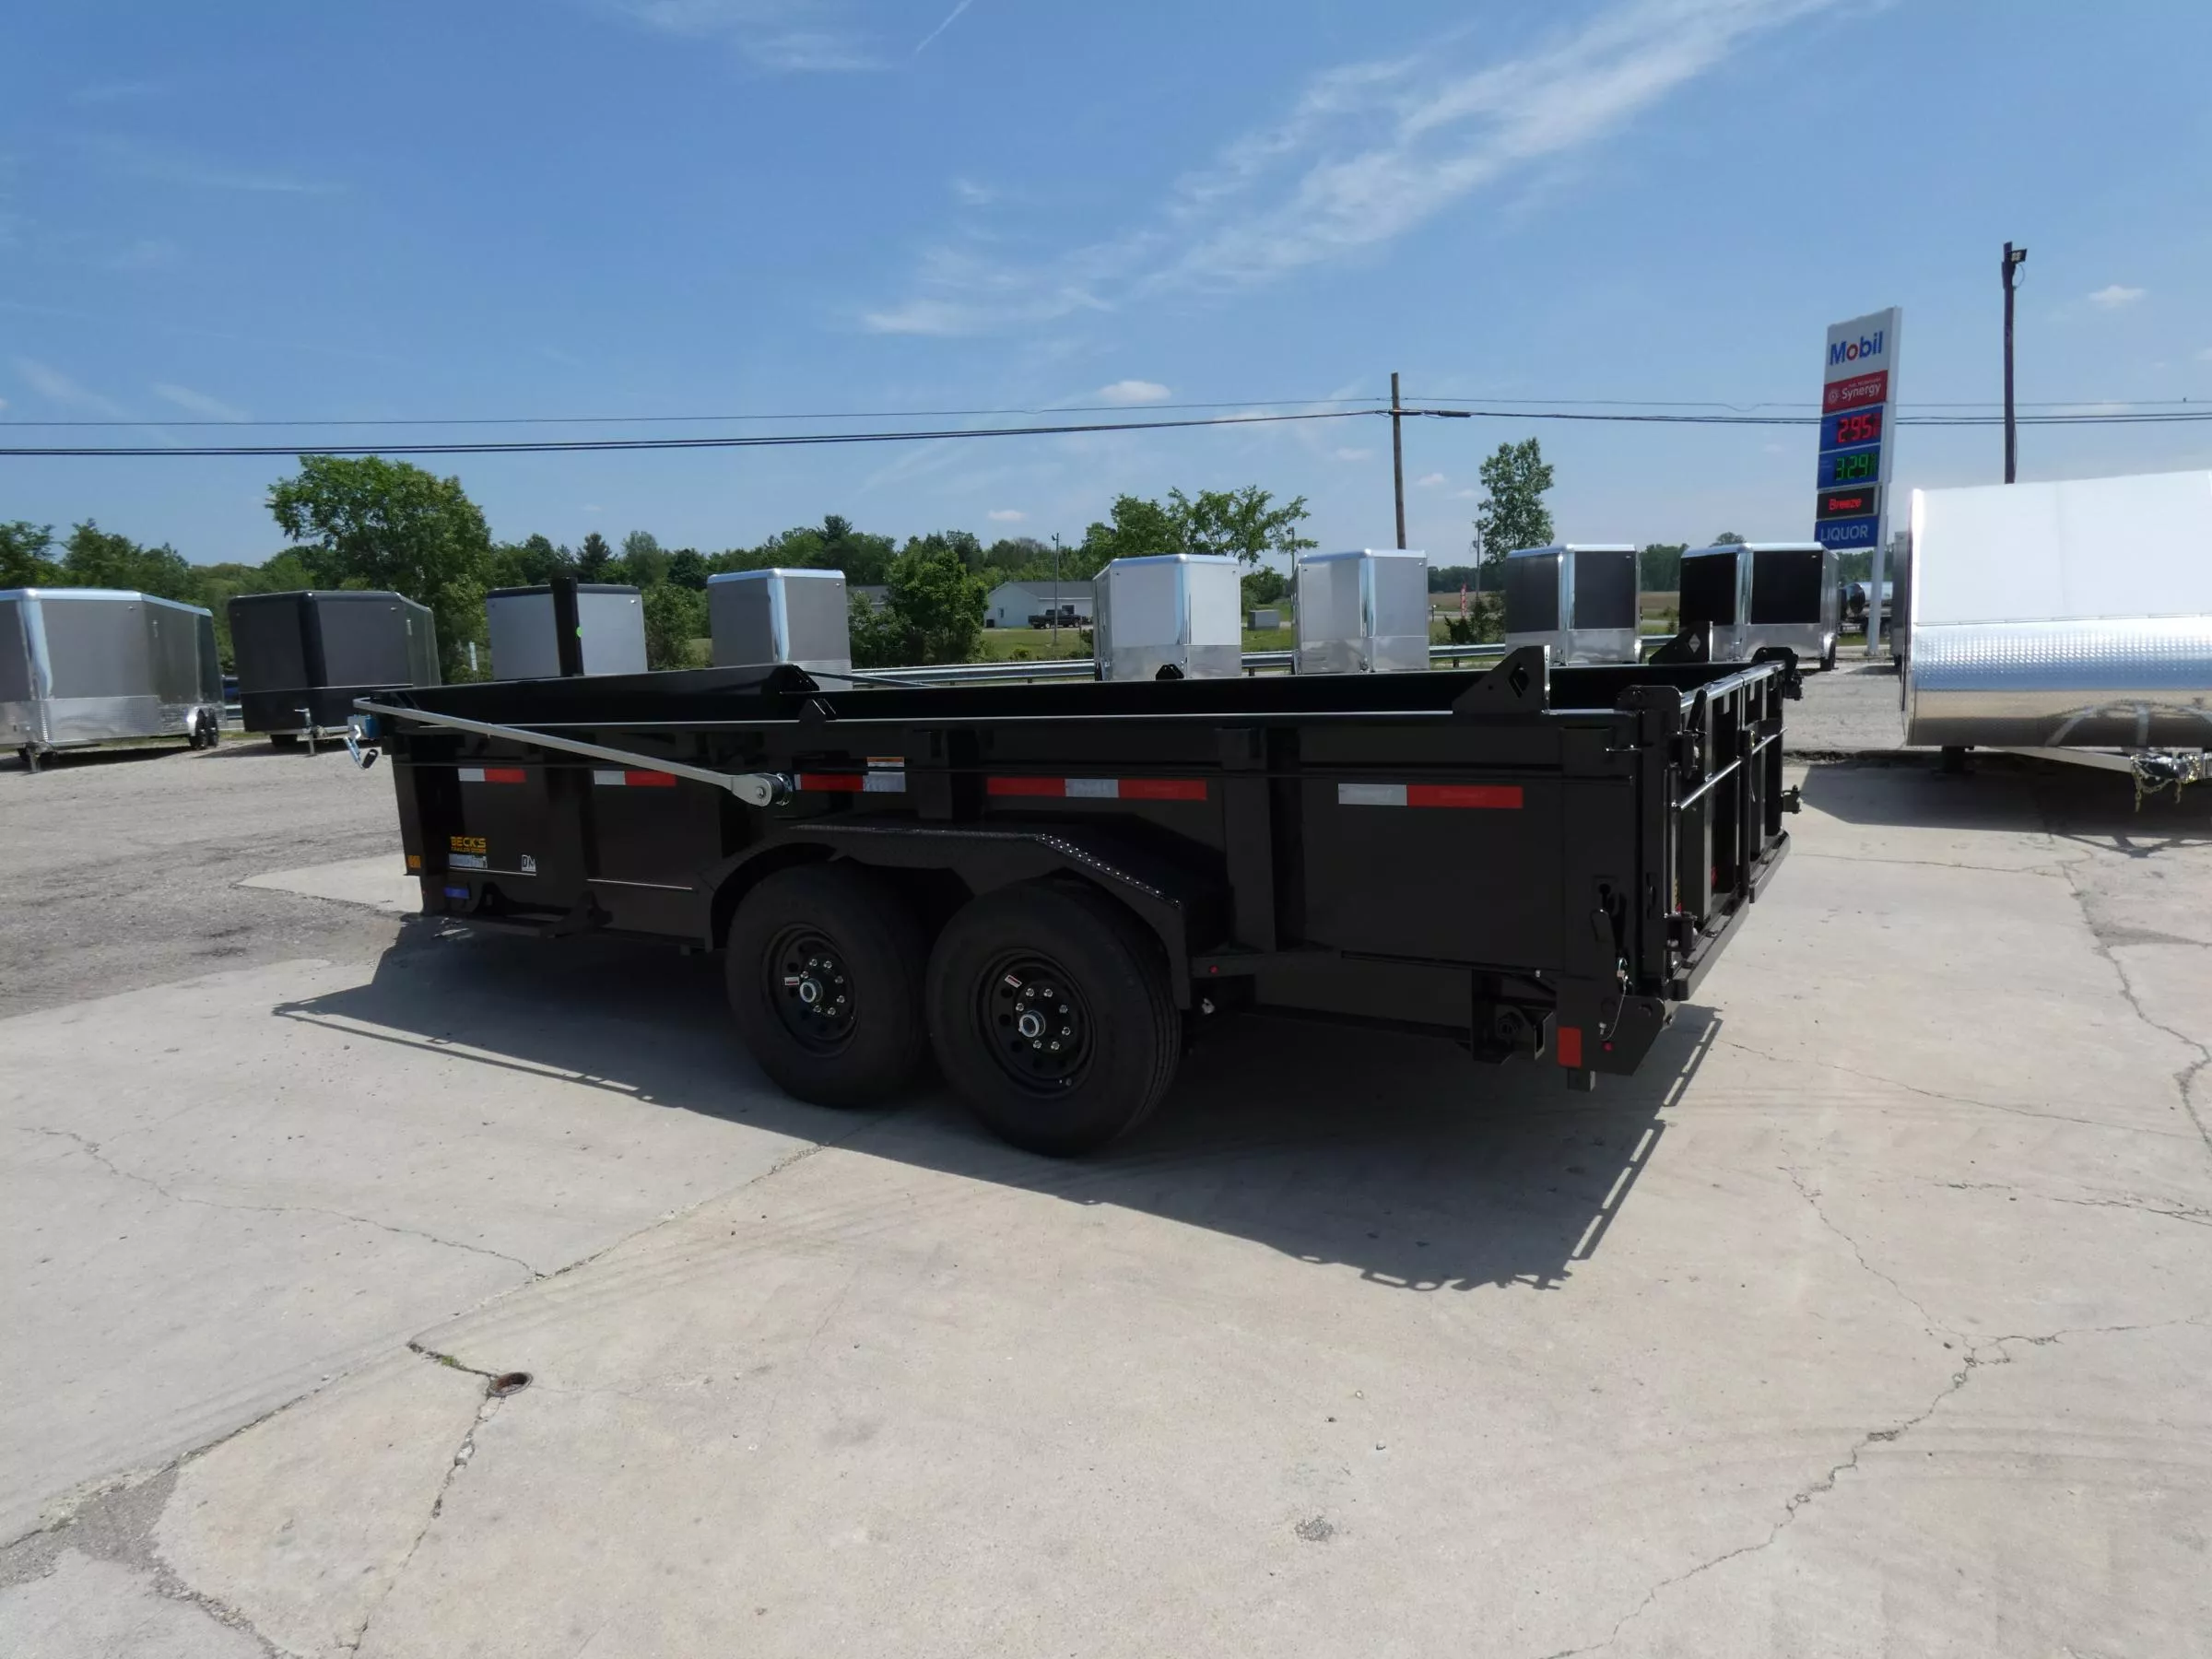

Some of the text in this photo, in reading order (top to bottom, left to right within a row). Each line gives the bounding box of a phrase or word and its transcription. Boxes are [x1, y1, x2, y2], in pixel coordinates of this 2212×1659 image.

[1830, 331, 1883, 366] Mobil
[1841, 382, 1881, 401] Synergy
[1820, 524, 1868, 542] LIQUOR
